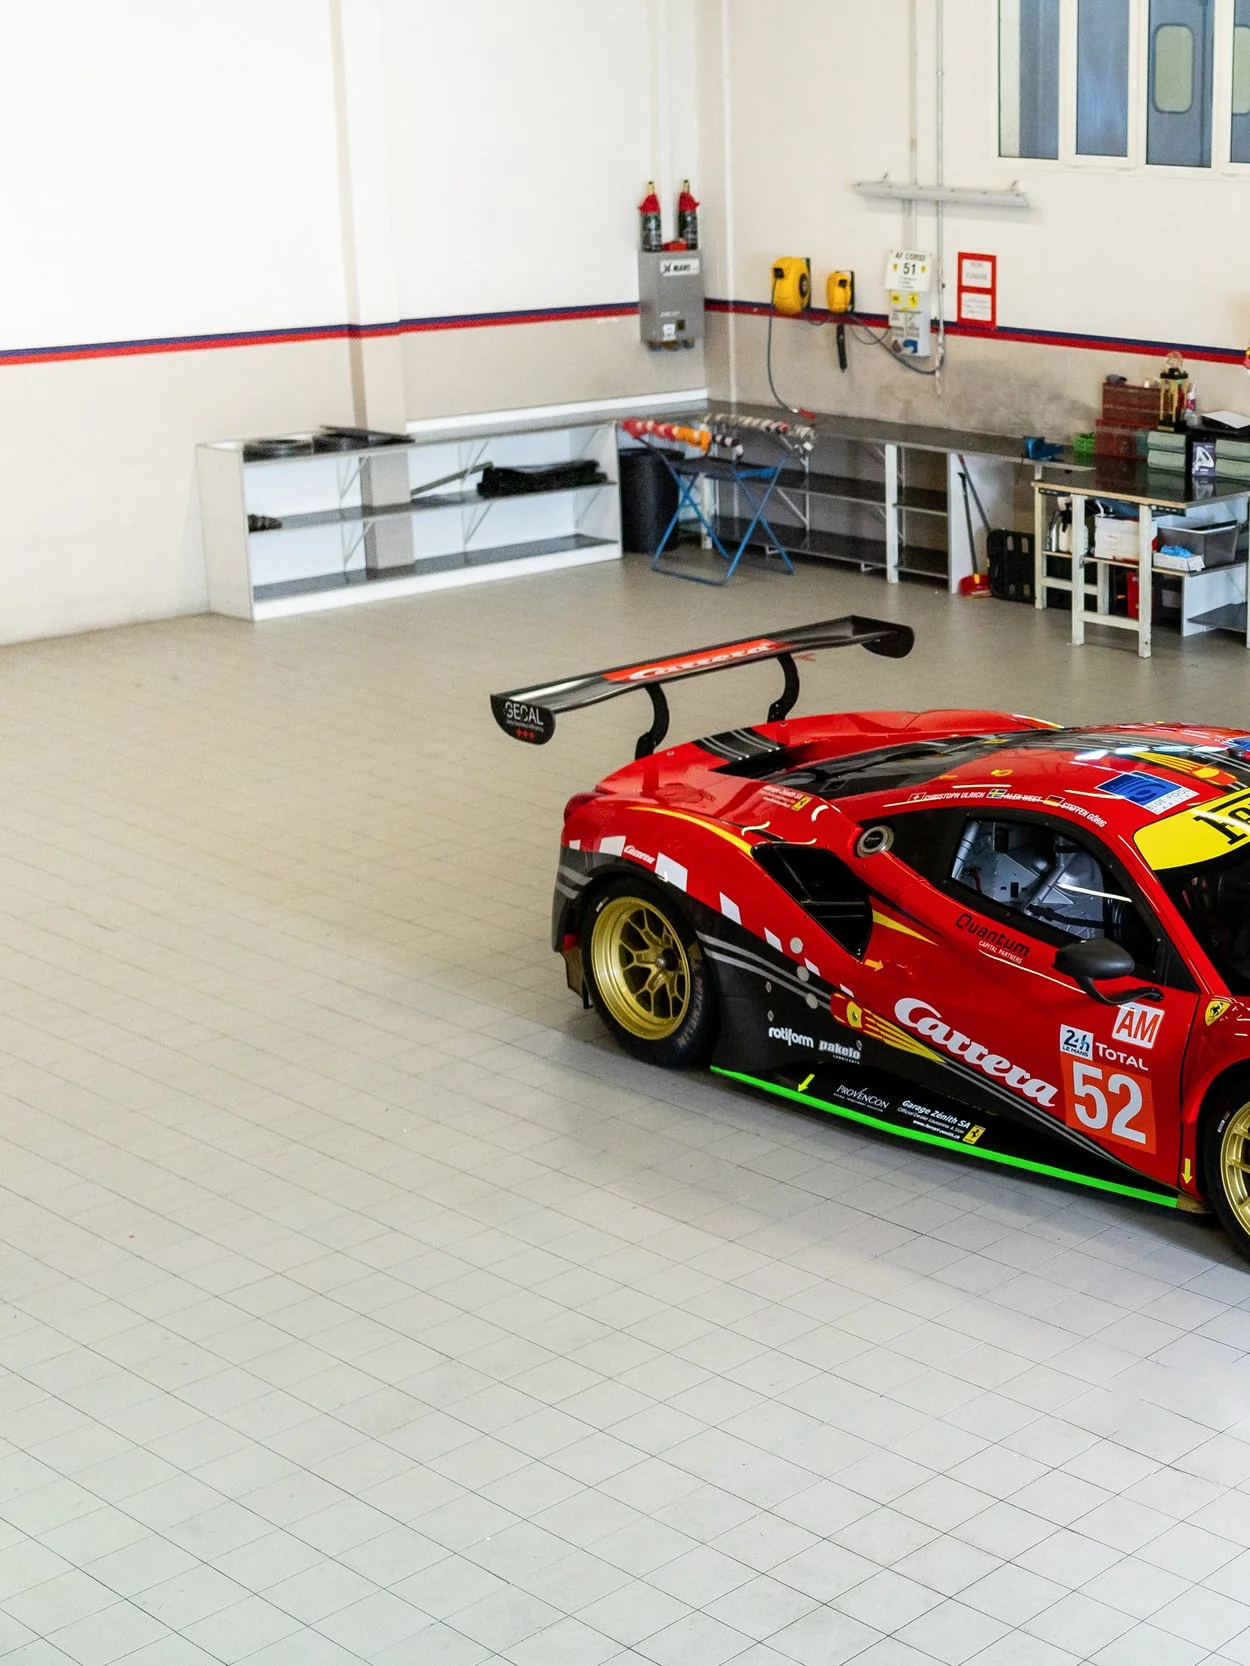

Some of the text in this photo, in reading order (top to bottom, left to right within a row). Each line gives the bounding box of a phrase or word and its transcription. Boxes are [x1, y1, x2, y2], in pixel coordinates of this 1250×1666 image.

[904, 262, 916, 275] 51
[955, 913, 1030, 956] Quantum
[979, 940, 1023, 964] CAPITAL PARTNERS
[768, 1027, 814, 1048] rotiform
[1116, 1008, 1160, 1043] AM
[819, 1040, 860, 1060] pakelo
[894, 998, 1058, 1107] Carrera
[1064, 1030, 1090, 1052] 24h
[1071, 1048, 1089, 1058] MANS
[1095, 1042, 1148, 1071] TOTAL
[902, 1100, 971, 1128] Garage Zénith SA
[1073, 1061, 1146, 1144] 52
